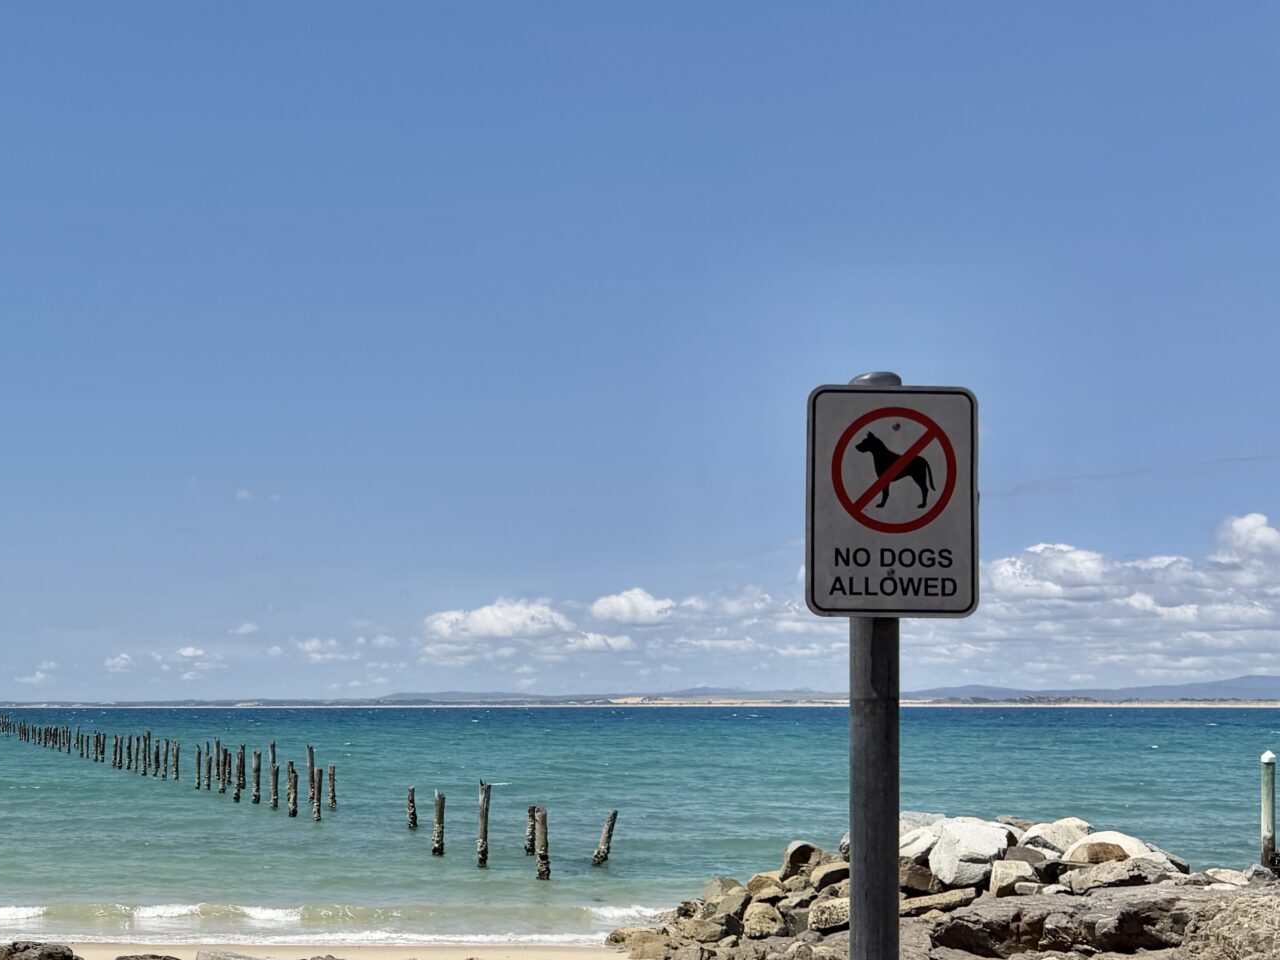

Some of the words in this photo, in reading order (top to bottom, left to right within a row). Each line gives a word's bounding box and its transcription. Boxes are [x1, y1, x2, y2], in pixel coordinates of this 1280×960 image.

[834, 547, 871, 568] NO
[880, 548, 953, 568] DOGS
[829, 576, 958, 597] ALLOWED
